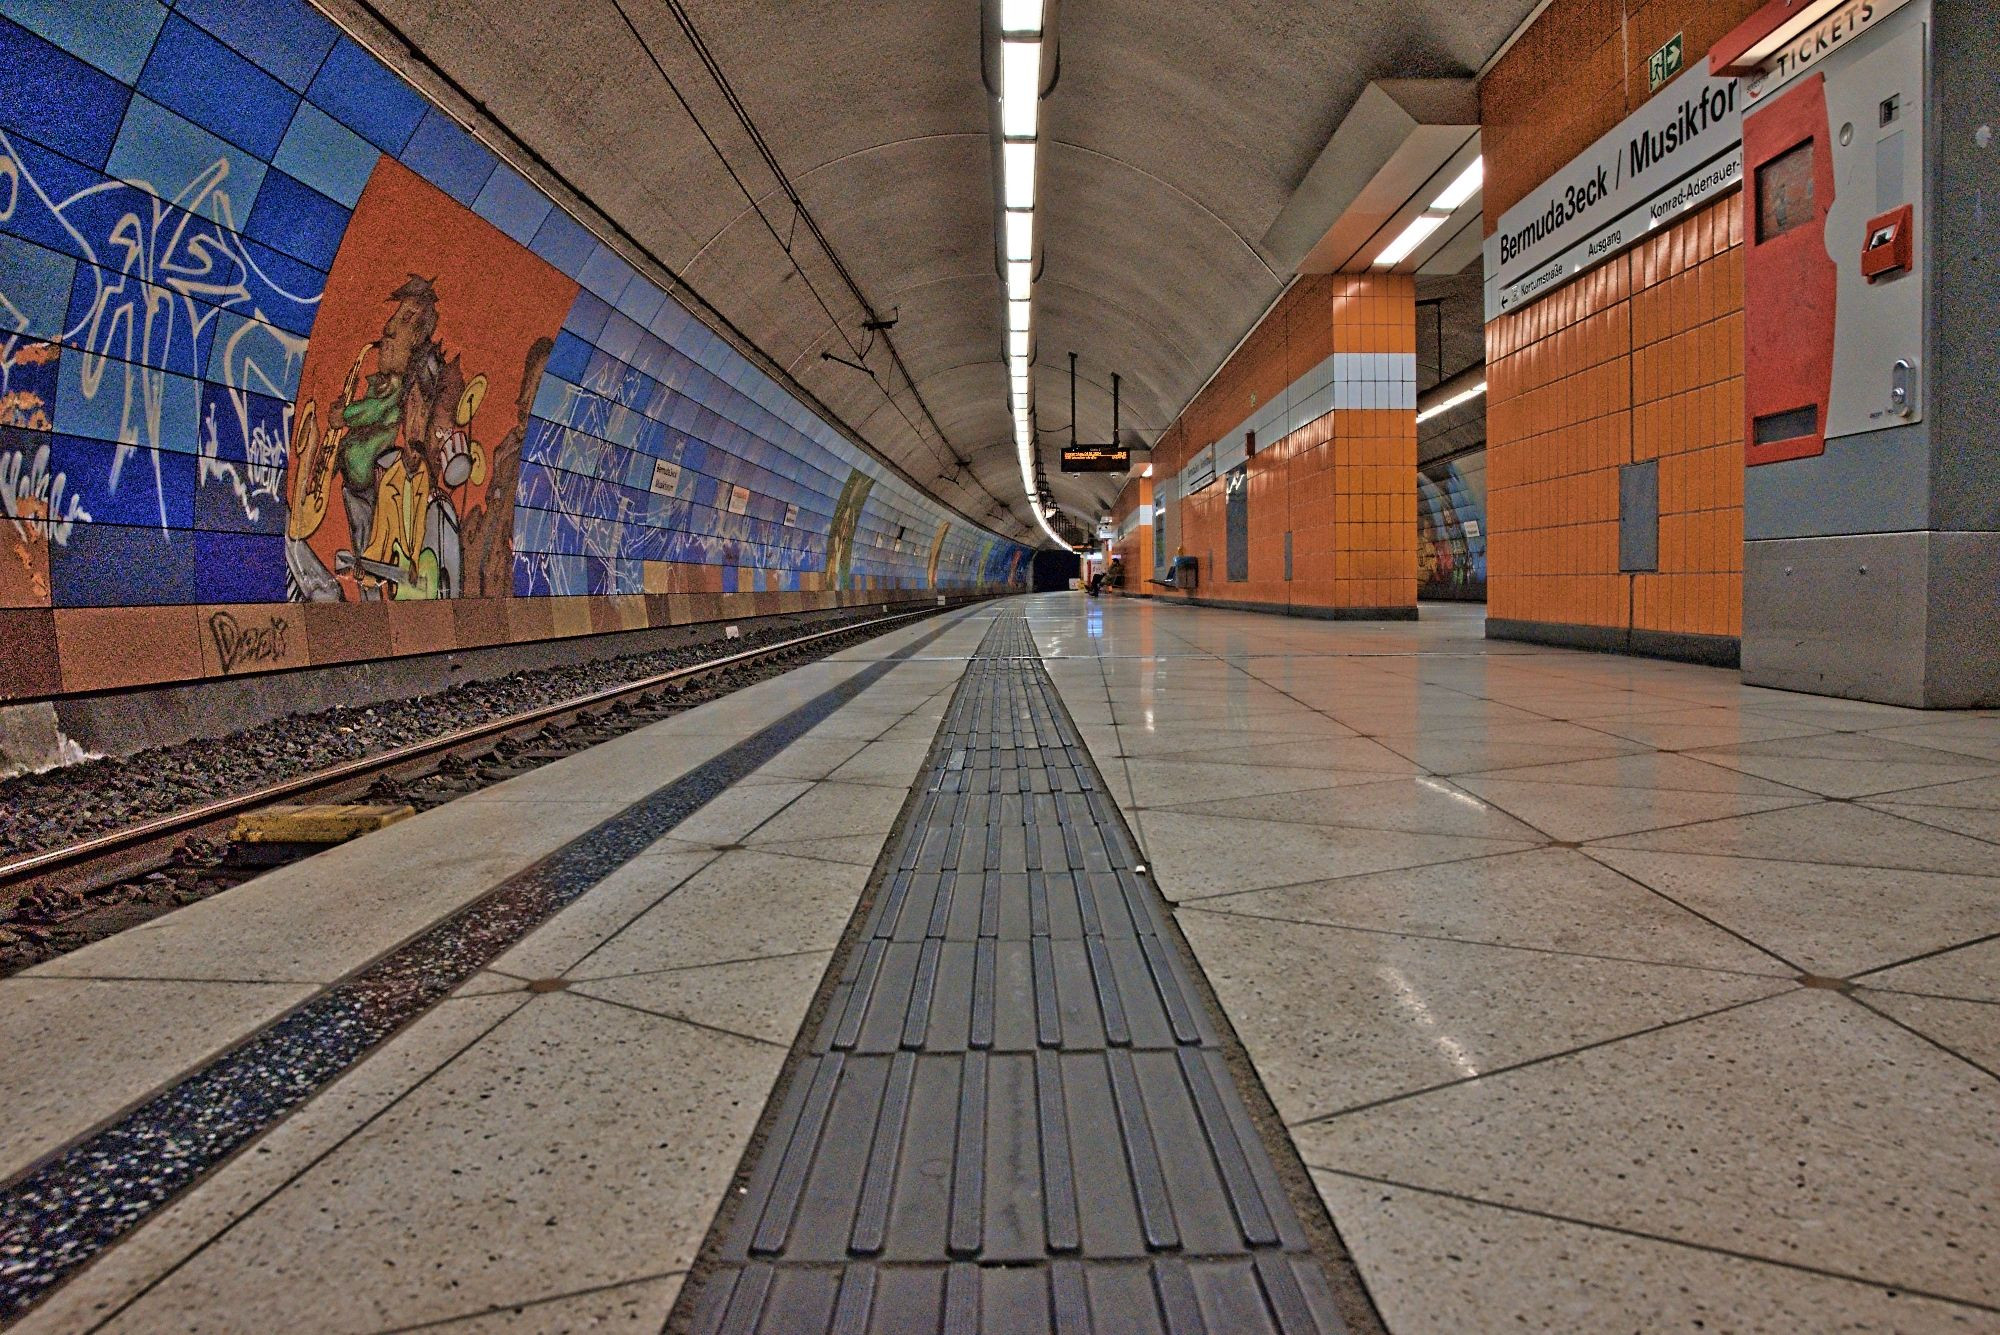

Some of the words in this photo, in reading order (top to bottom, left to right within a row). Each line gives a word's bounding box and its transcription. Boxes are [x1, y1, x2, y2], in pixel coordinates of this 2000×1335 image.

[1777, 0, 1874, 77] TICKETS
[1500, 165, 1608, 266] Bermuda3eck
[1630, 78, 1738, 179] Musikfor
[1650, 151, 1742, 219] Konrad-Adenauer-
[1587, 230, 1622, 257] Ausgang
